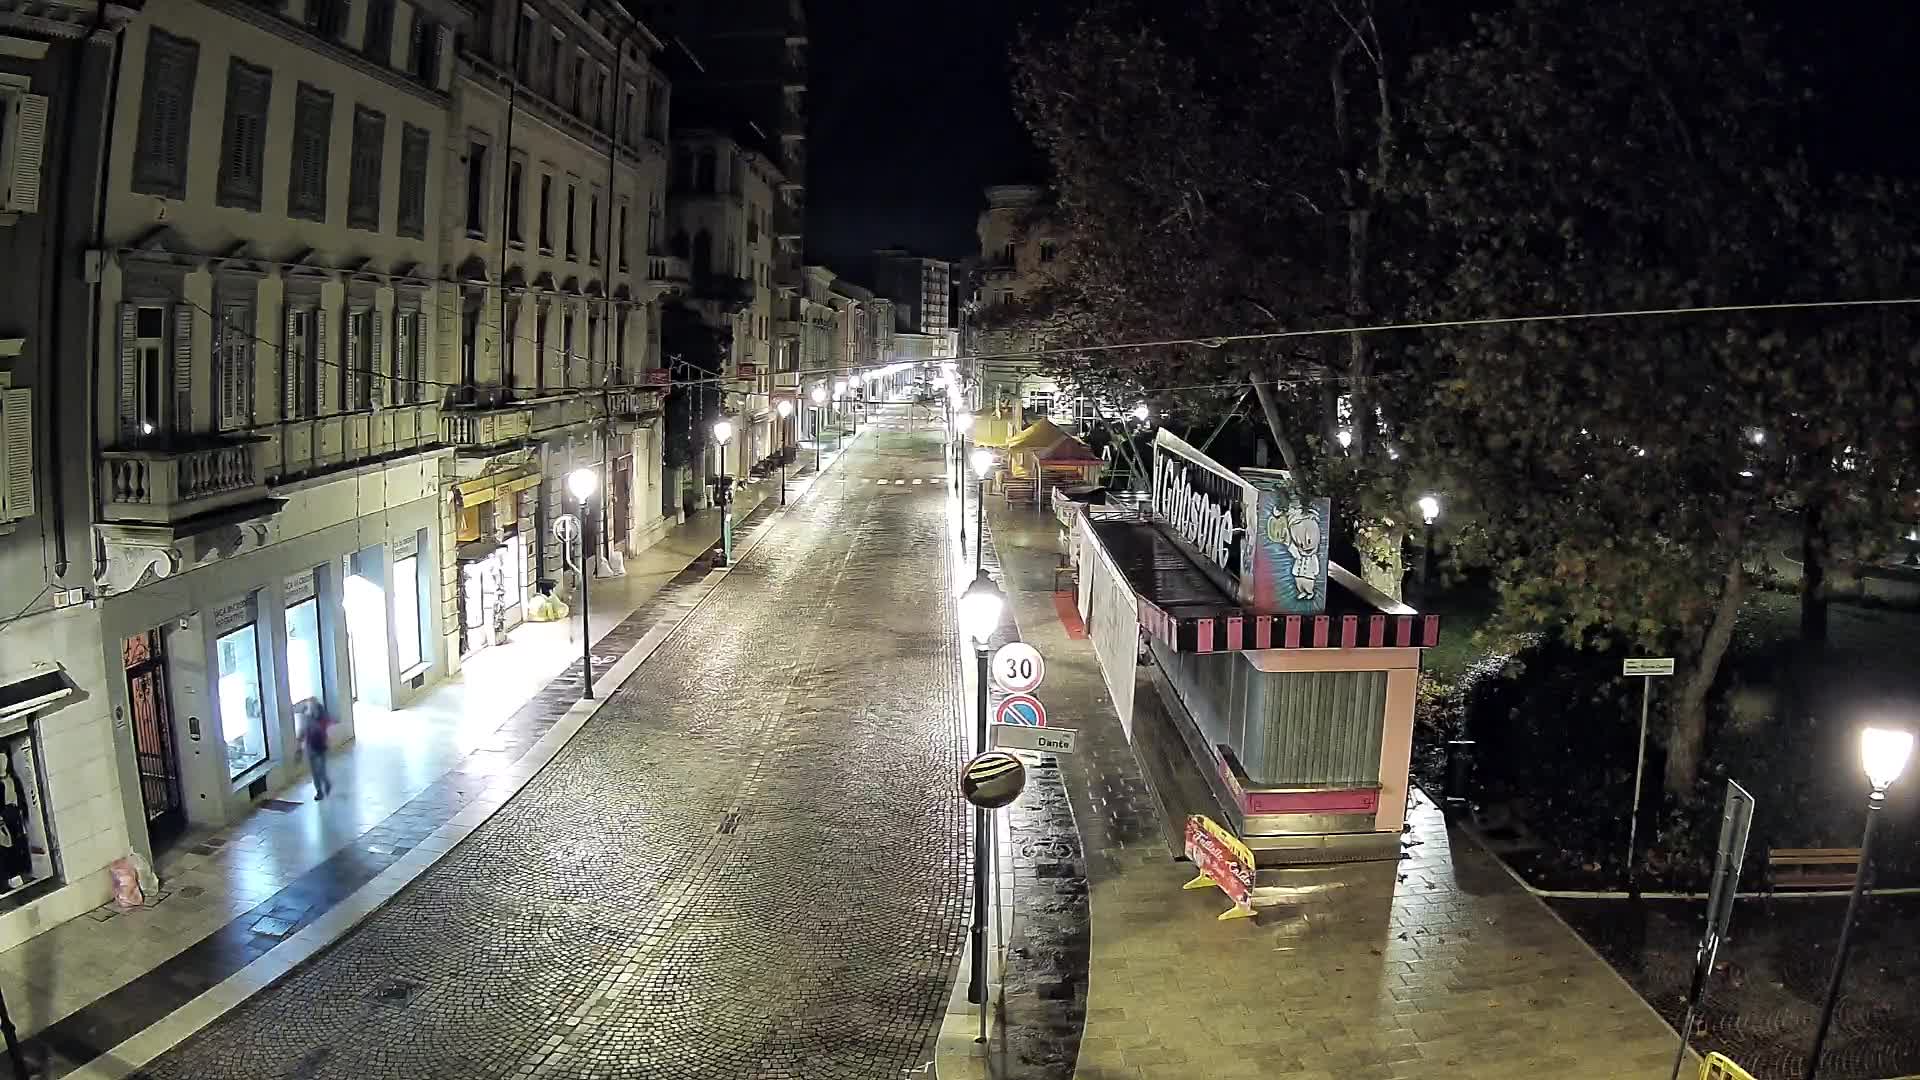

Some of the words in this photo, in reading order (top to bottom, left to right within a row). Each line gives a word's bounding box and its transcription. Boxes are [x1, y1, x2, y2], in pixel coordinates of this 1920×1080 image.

[1162, 459, 1233, 568] Golosone
[1006, 659, 1032, 679] 30
[1038, 737, 1070, 749] Dante
